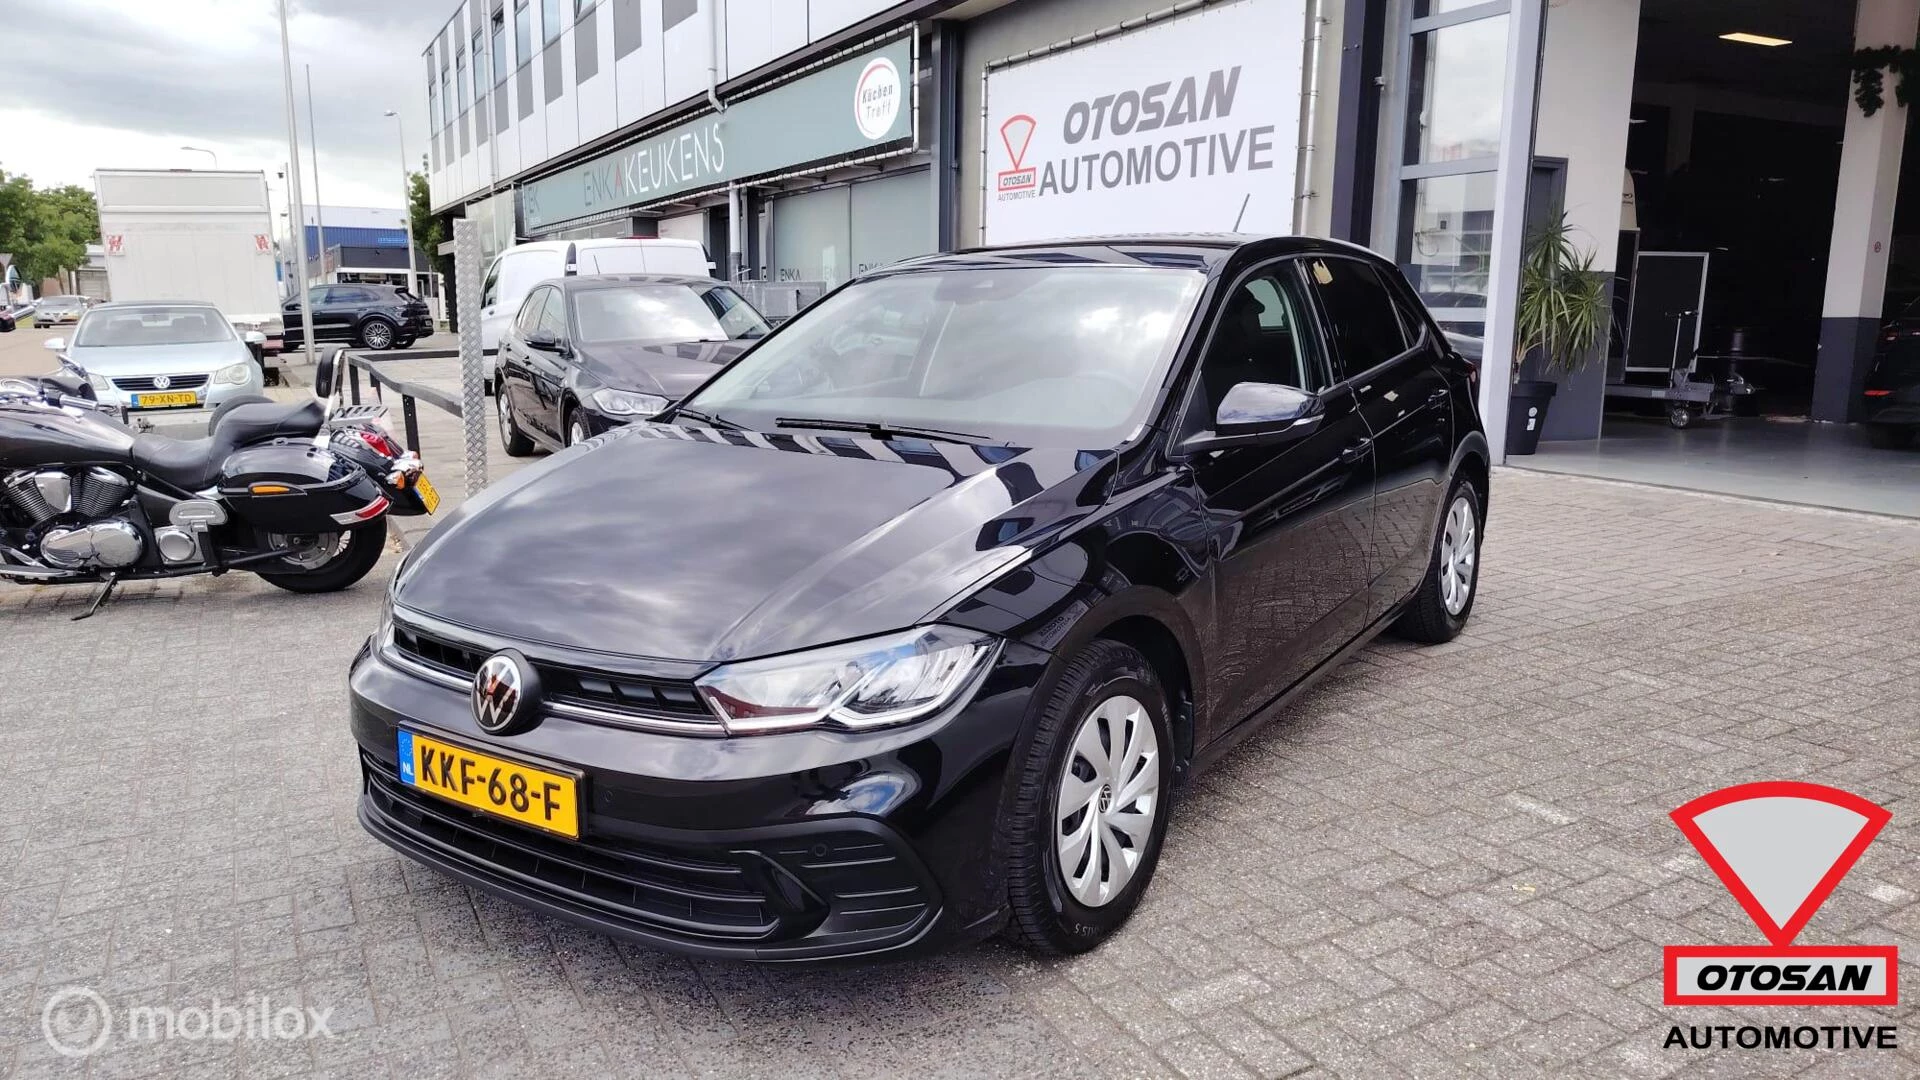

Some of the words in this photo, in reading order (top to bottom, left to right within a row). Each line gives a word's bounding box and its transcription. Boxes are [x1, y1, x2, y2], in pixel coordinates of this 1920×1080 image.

[1063, 65, 1242, 145] OTOSAN
[1038, 124, 1275, 197] AUTOMOTIVE
[1003, 174, 1032, 186] OTOSAN
[998, 190, 1036, 201] AUTOMOTIVE
[141, 393, 193, 405] 79-XN-TD
[402, 762, 414, 777] NL
[420, 745, 561, 821] KKF-68-F
